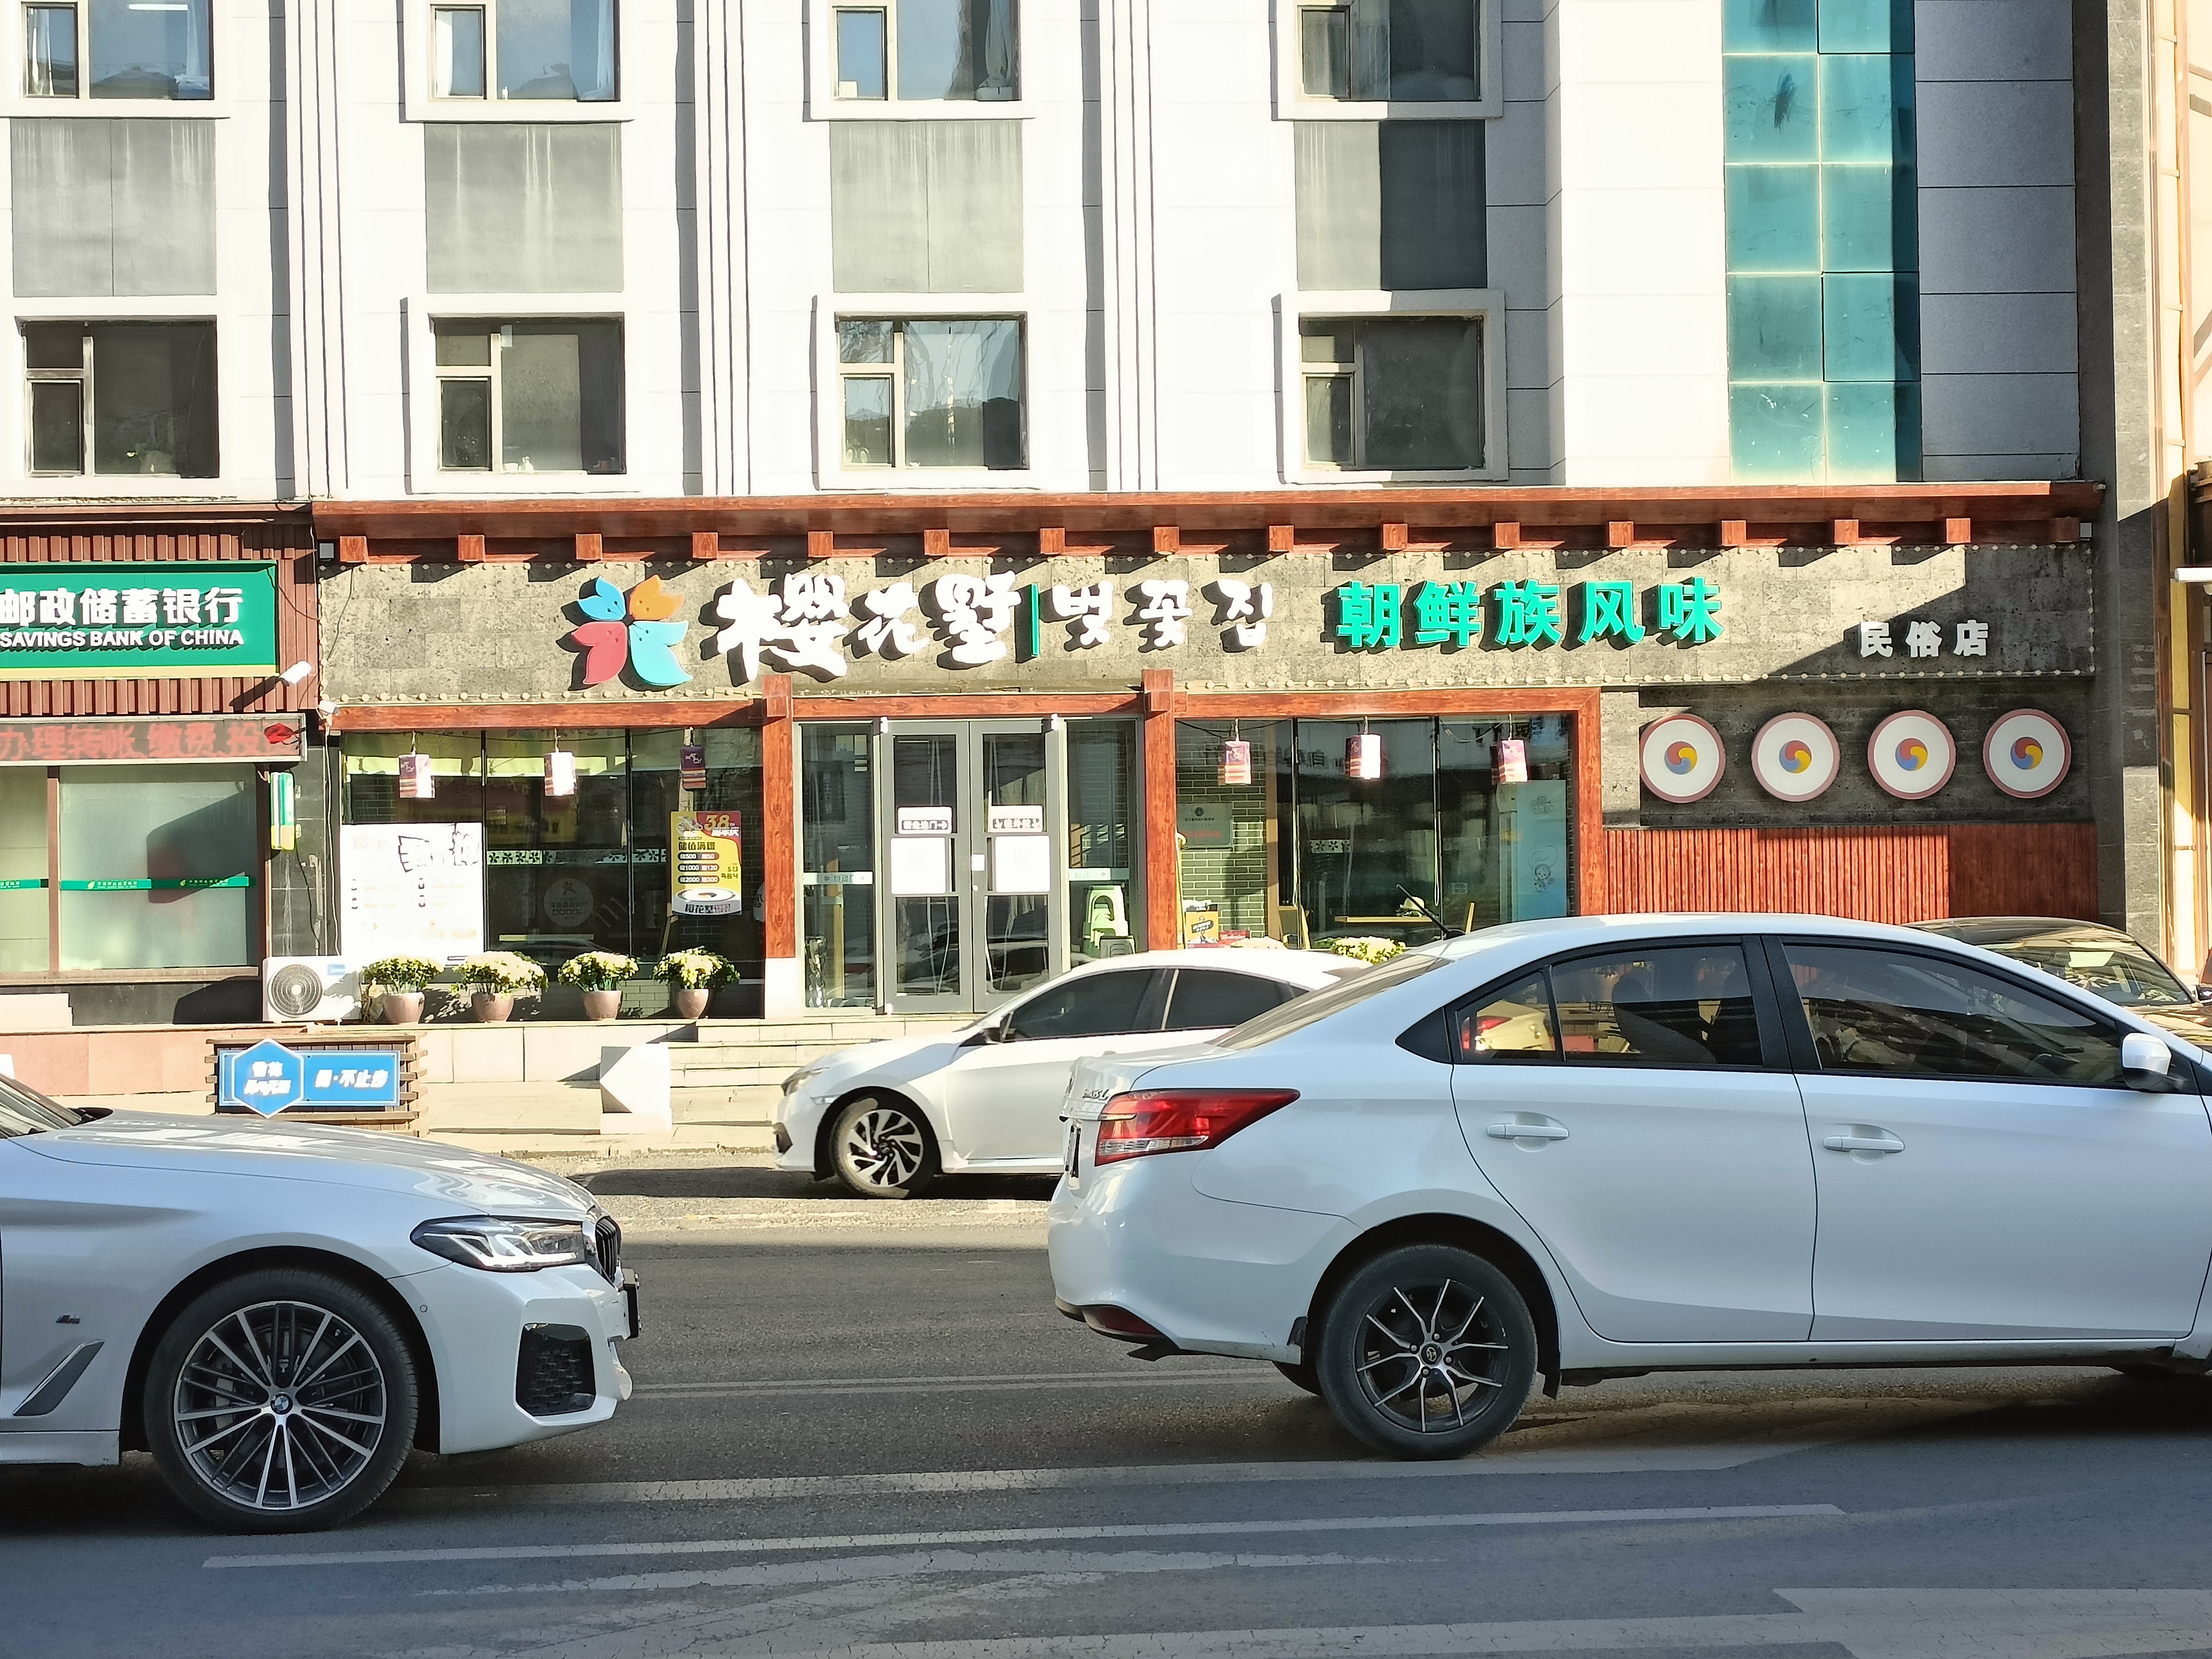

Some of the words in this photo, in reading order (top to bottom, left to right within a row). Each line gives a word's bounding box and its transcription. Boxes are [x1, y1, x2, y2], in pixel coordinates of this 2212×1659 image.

[0, 587, 243, 626] 邮政储蓄银行
[717, 571, 1022, 681] 樱花墅
[1336, 576, 1724, 648] 朝鲜族风味
[0, 630, 86, 648] SAVINGS
[89, 630, 144, 647] BANK
[148, 630, 177, 647] OF
[181, 629, 244, 646] CHINA
[1860, 619, 1989, 658] 民俗店
[704, 814, 730, 831] 38
